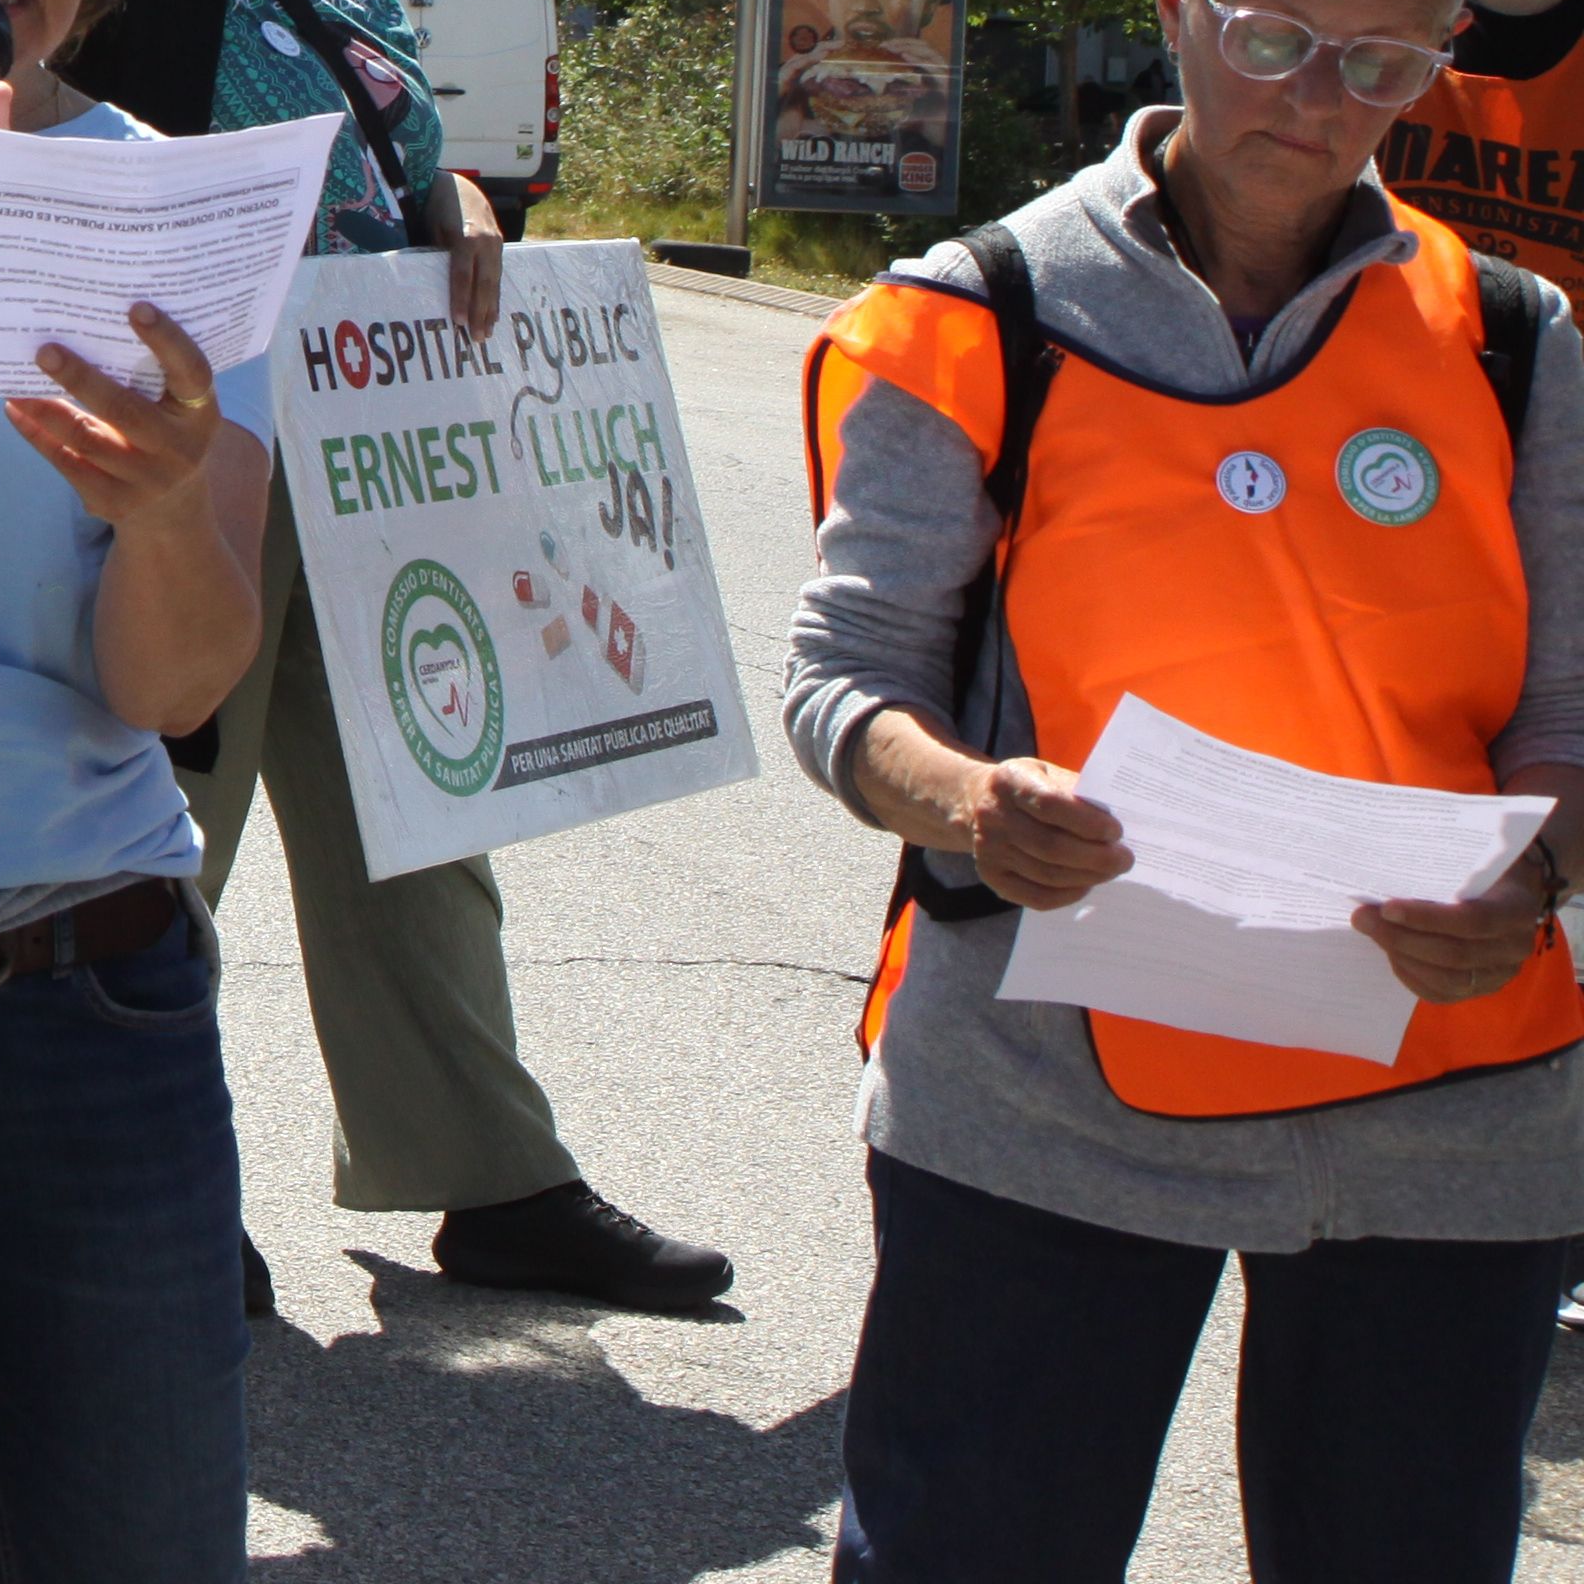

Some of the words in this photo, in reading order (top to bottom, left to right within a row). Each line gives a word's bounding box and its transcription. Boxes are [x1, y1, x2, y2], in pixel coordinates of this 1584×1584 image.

[833, 141, 897, 165] RANCH
[36, 212, 52, 222] ES
[171, 212, 215, 227] GOVERNI
[217, 208, 235, 219] QUI
[237, 199, 279, 217] GOVERNI
[1411, 195, 1581, 244] ENSIONISTA
[108, 222, 154, 234] SANITAT
[156, 222, 170, 232] LA
[300, 318, 503, 392] HOSPITAL
[511, 296, 640, 372] PÚBLIC
[321, 420, 501, 516] ERNEST
[528, 401, 667, 487] LLUCH
[598, 460, 674, 571] JA!
[386, 570, 417, 658] COMISSIÓ
[419, 568, 484, 642] D'ENTITATS
[396, 697, 416, 741] PER
[416, 741, 431, 769] LA
[435, 760, 483, 788] SANITAT
[511, 753, 533, 775] PER
[535, 748, 560, 770] UNA
[560, 734, 604, 764] SANITAT
[603, 724, 649, 752] PÚBLICA
[649, 722, 664, 740] DE
[664, 708, 712, 740] QUALITAT
